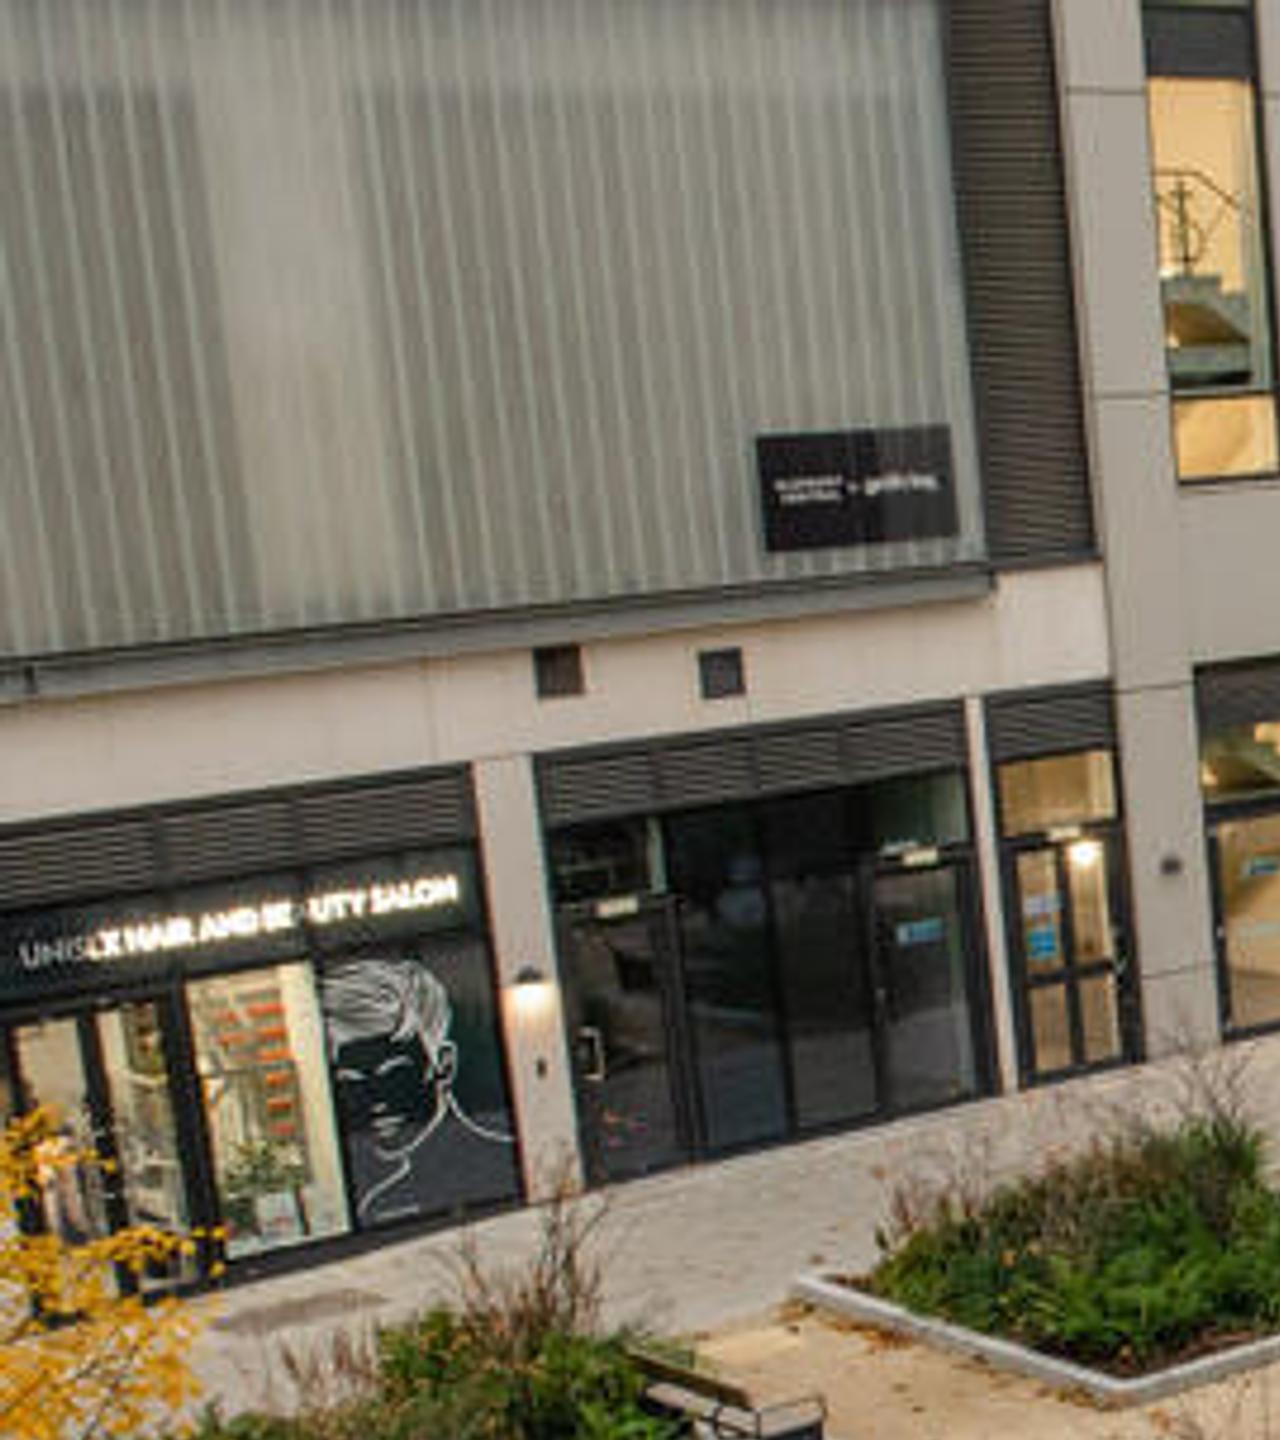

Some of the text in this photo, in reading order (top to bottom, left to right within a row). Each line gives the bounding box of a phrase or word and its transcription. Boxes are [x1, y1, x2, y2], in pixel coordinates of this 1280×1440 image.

[122, 916, 196, 952] HAIR
[200, 907, 258, 942] AND
[369, 875, 459, 914] SALON
